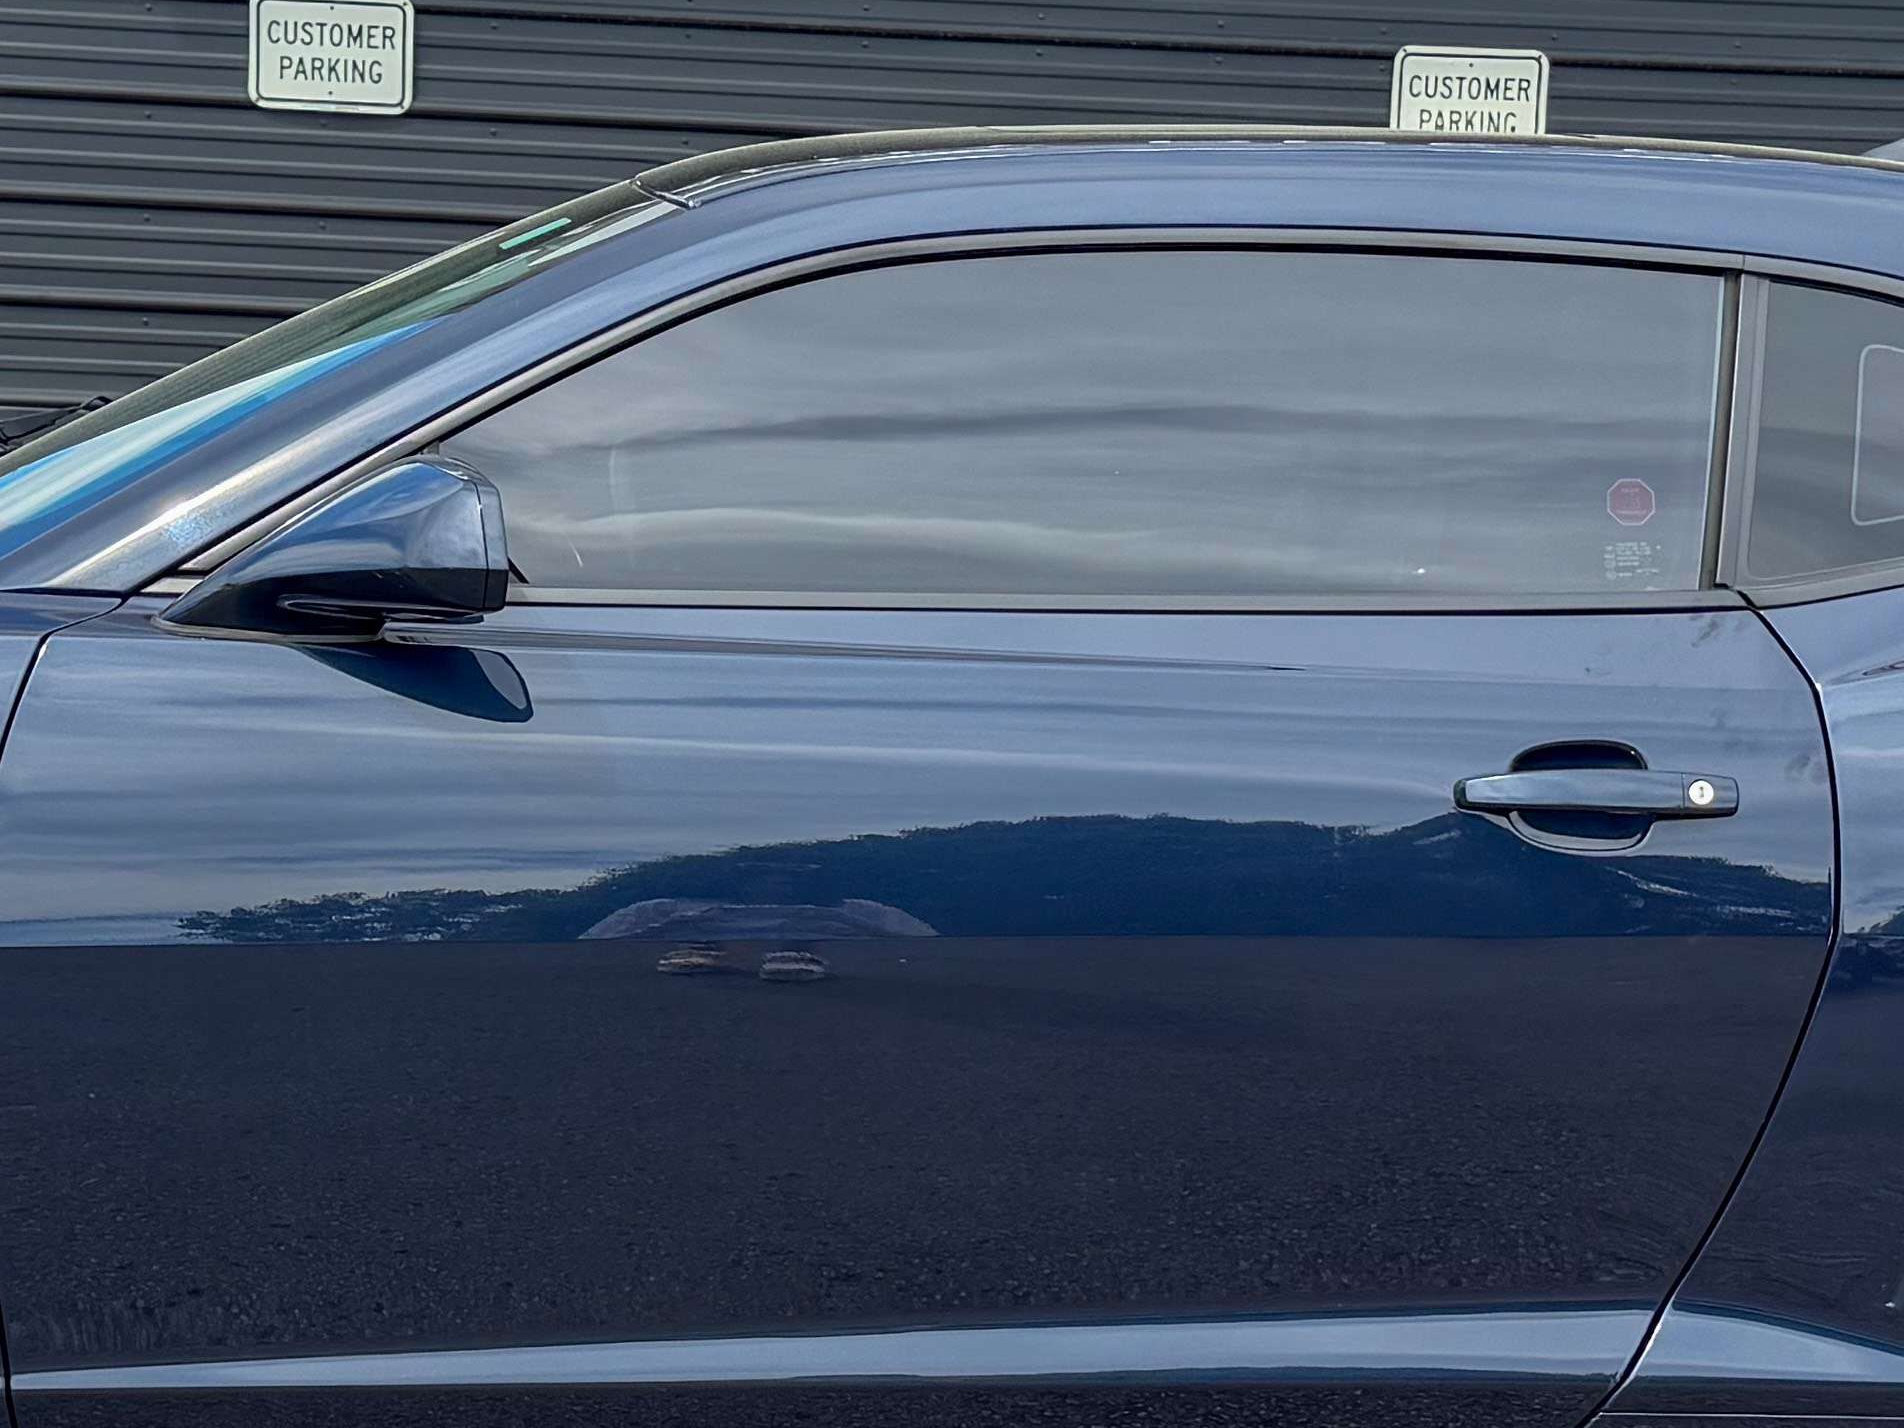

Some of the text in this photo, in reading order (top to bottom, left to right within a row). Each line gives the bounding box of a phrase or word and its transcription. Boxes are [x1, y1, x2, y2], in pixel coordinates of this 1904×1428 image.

[267, 19, 396, 50] CUSTOMER
[279, 55, 383, 84] PARKING
[1409, 74, 1531, 102] CUSTOMER
[1419, 108, 1518, 133] PARKING
